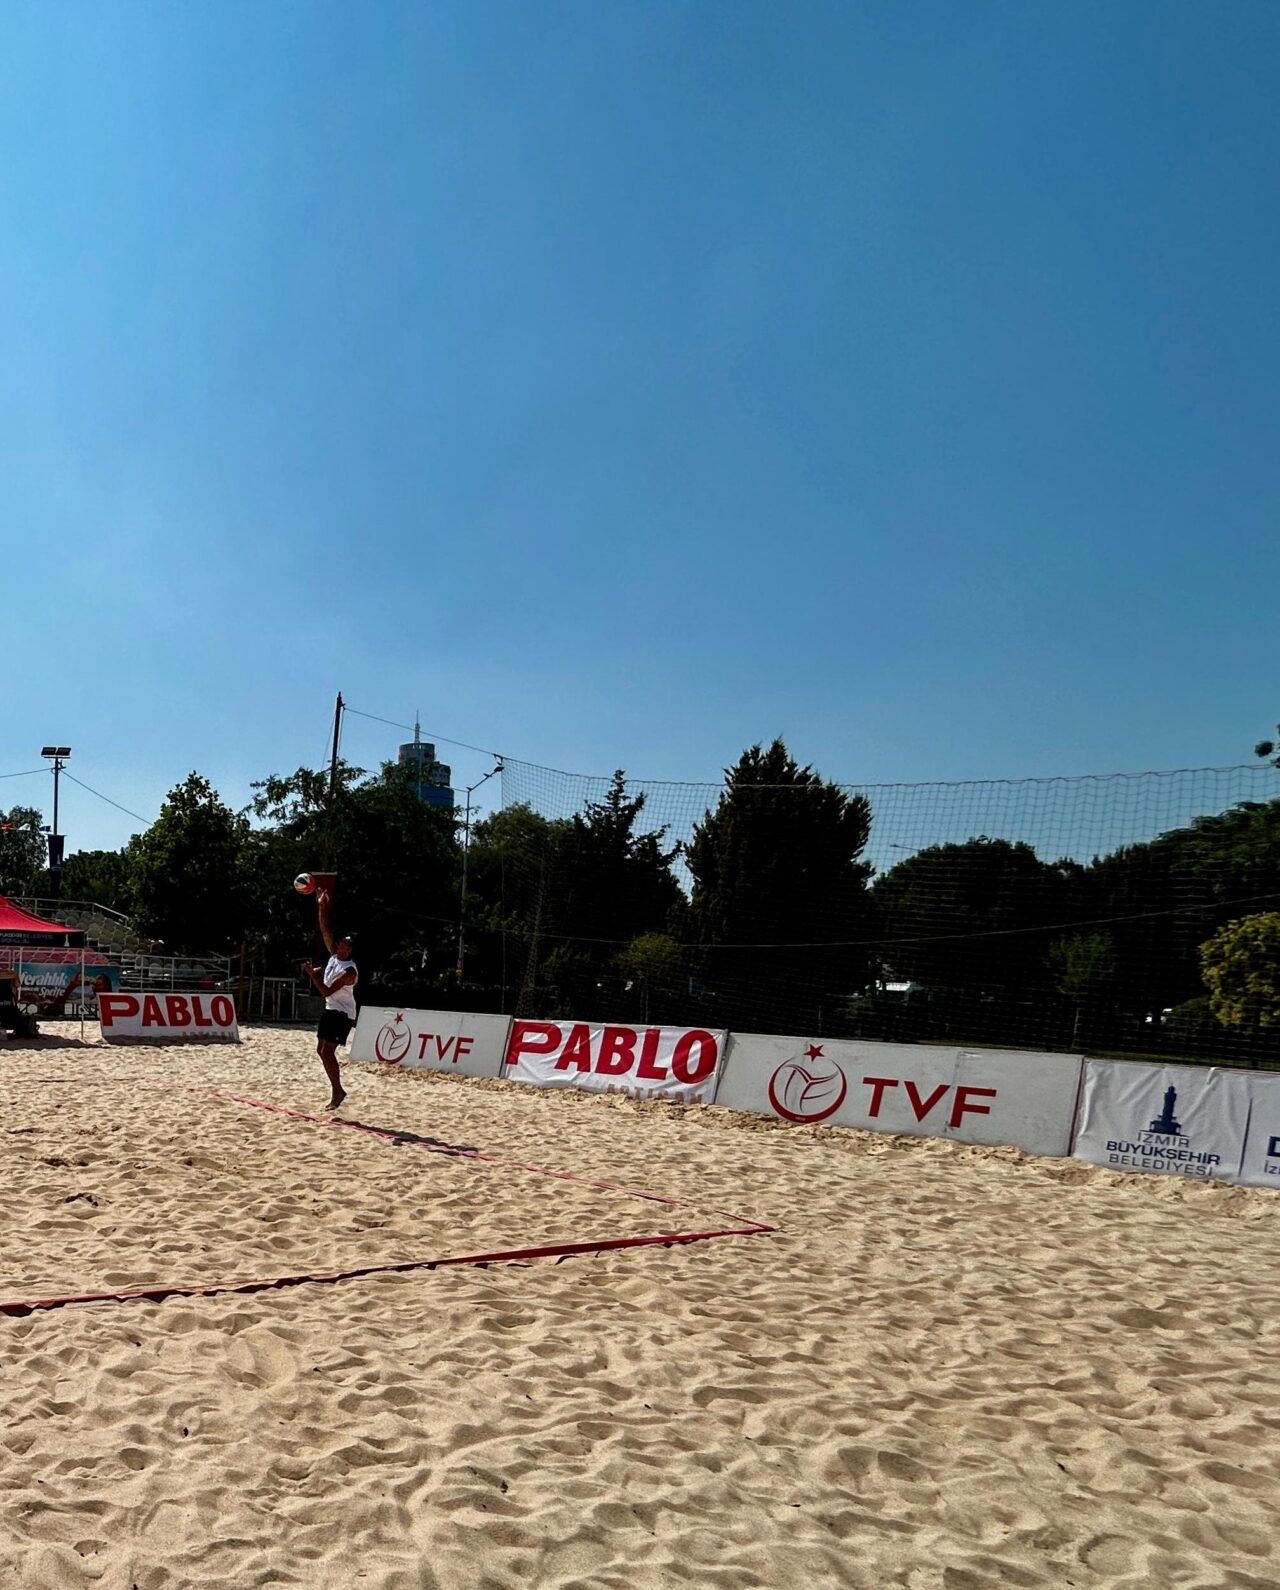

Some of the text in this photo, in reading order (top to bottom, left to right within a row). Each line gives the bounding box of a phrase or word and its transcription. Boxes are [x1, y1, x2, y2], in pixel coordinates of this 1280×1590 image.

[98, 994, 235, 1028] PABLO
[418, 1033, 474, 1064] TVF
[505, 1021, 718, 1084] PABLO
[862, 1076, 997, 1129] TVF
